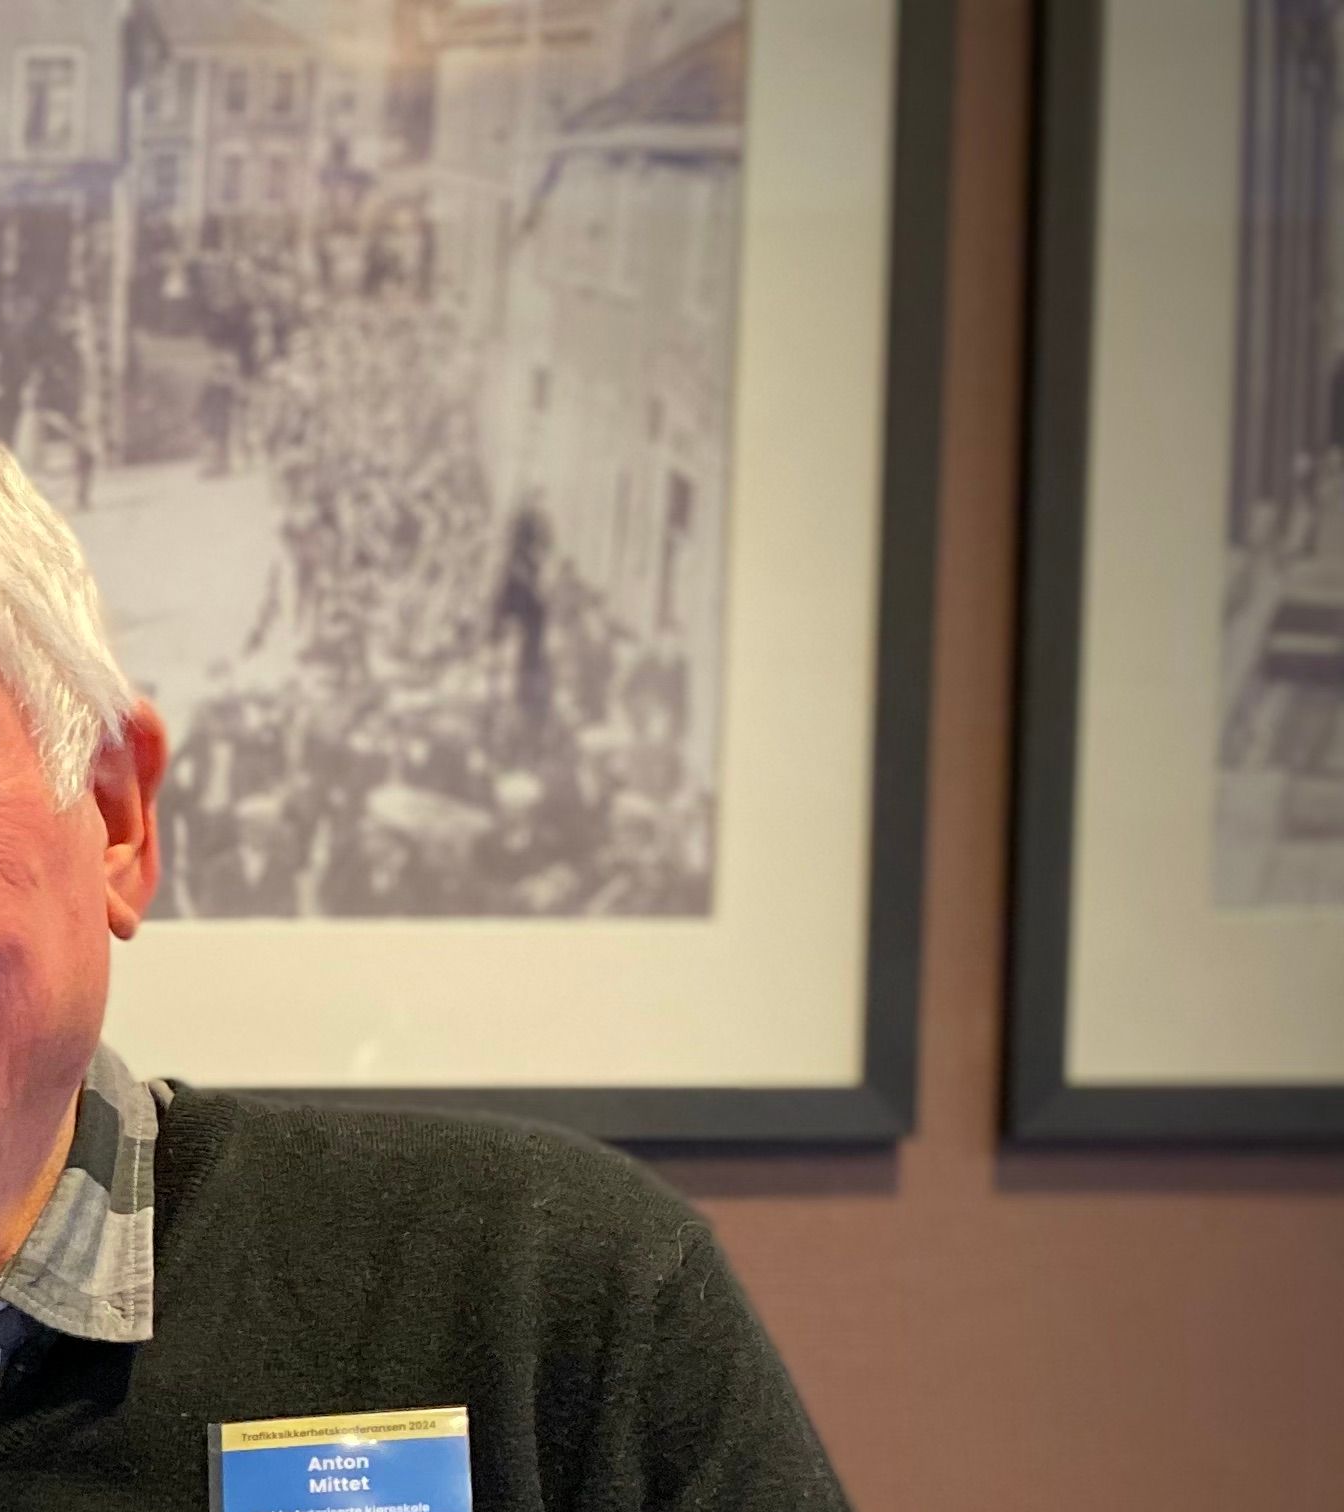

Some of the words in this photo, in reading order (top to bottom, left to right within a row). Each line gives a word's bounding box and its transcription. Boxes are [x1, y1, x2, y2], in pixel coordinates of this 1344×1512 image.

[409, 1420, 437, 1431] 2024
[308, 1455, 369, 1472] Anton
[310, 1475, 370, 1494] Mittet
